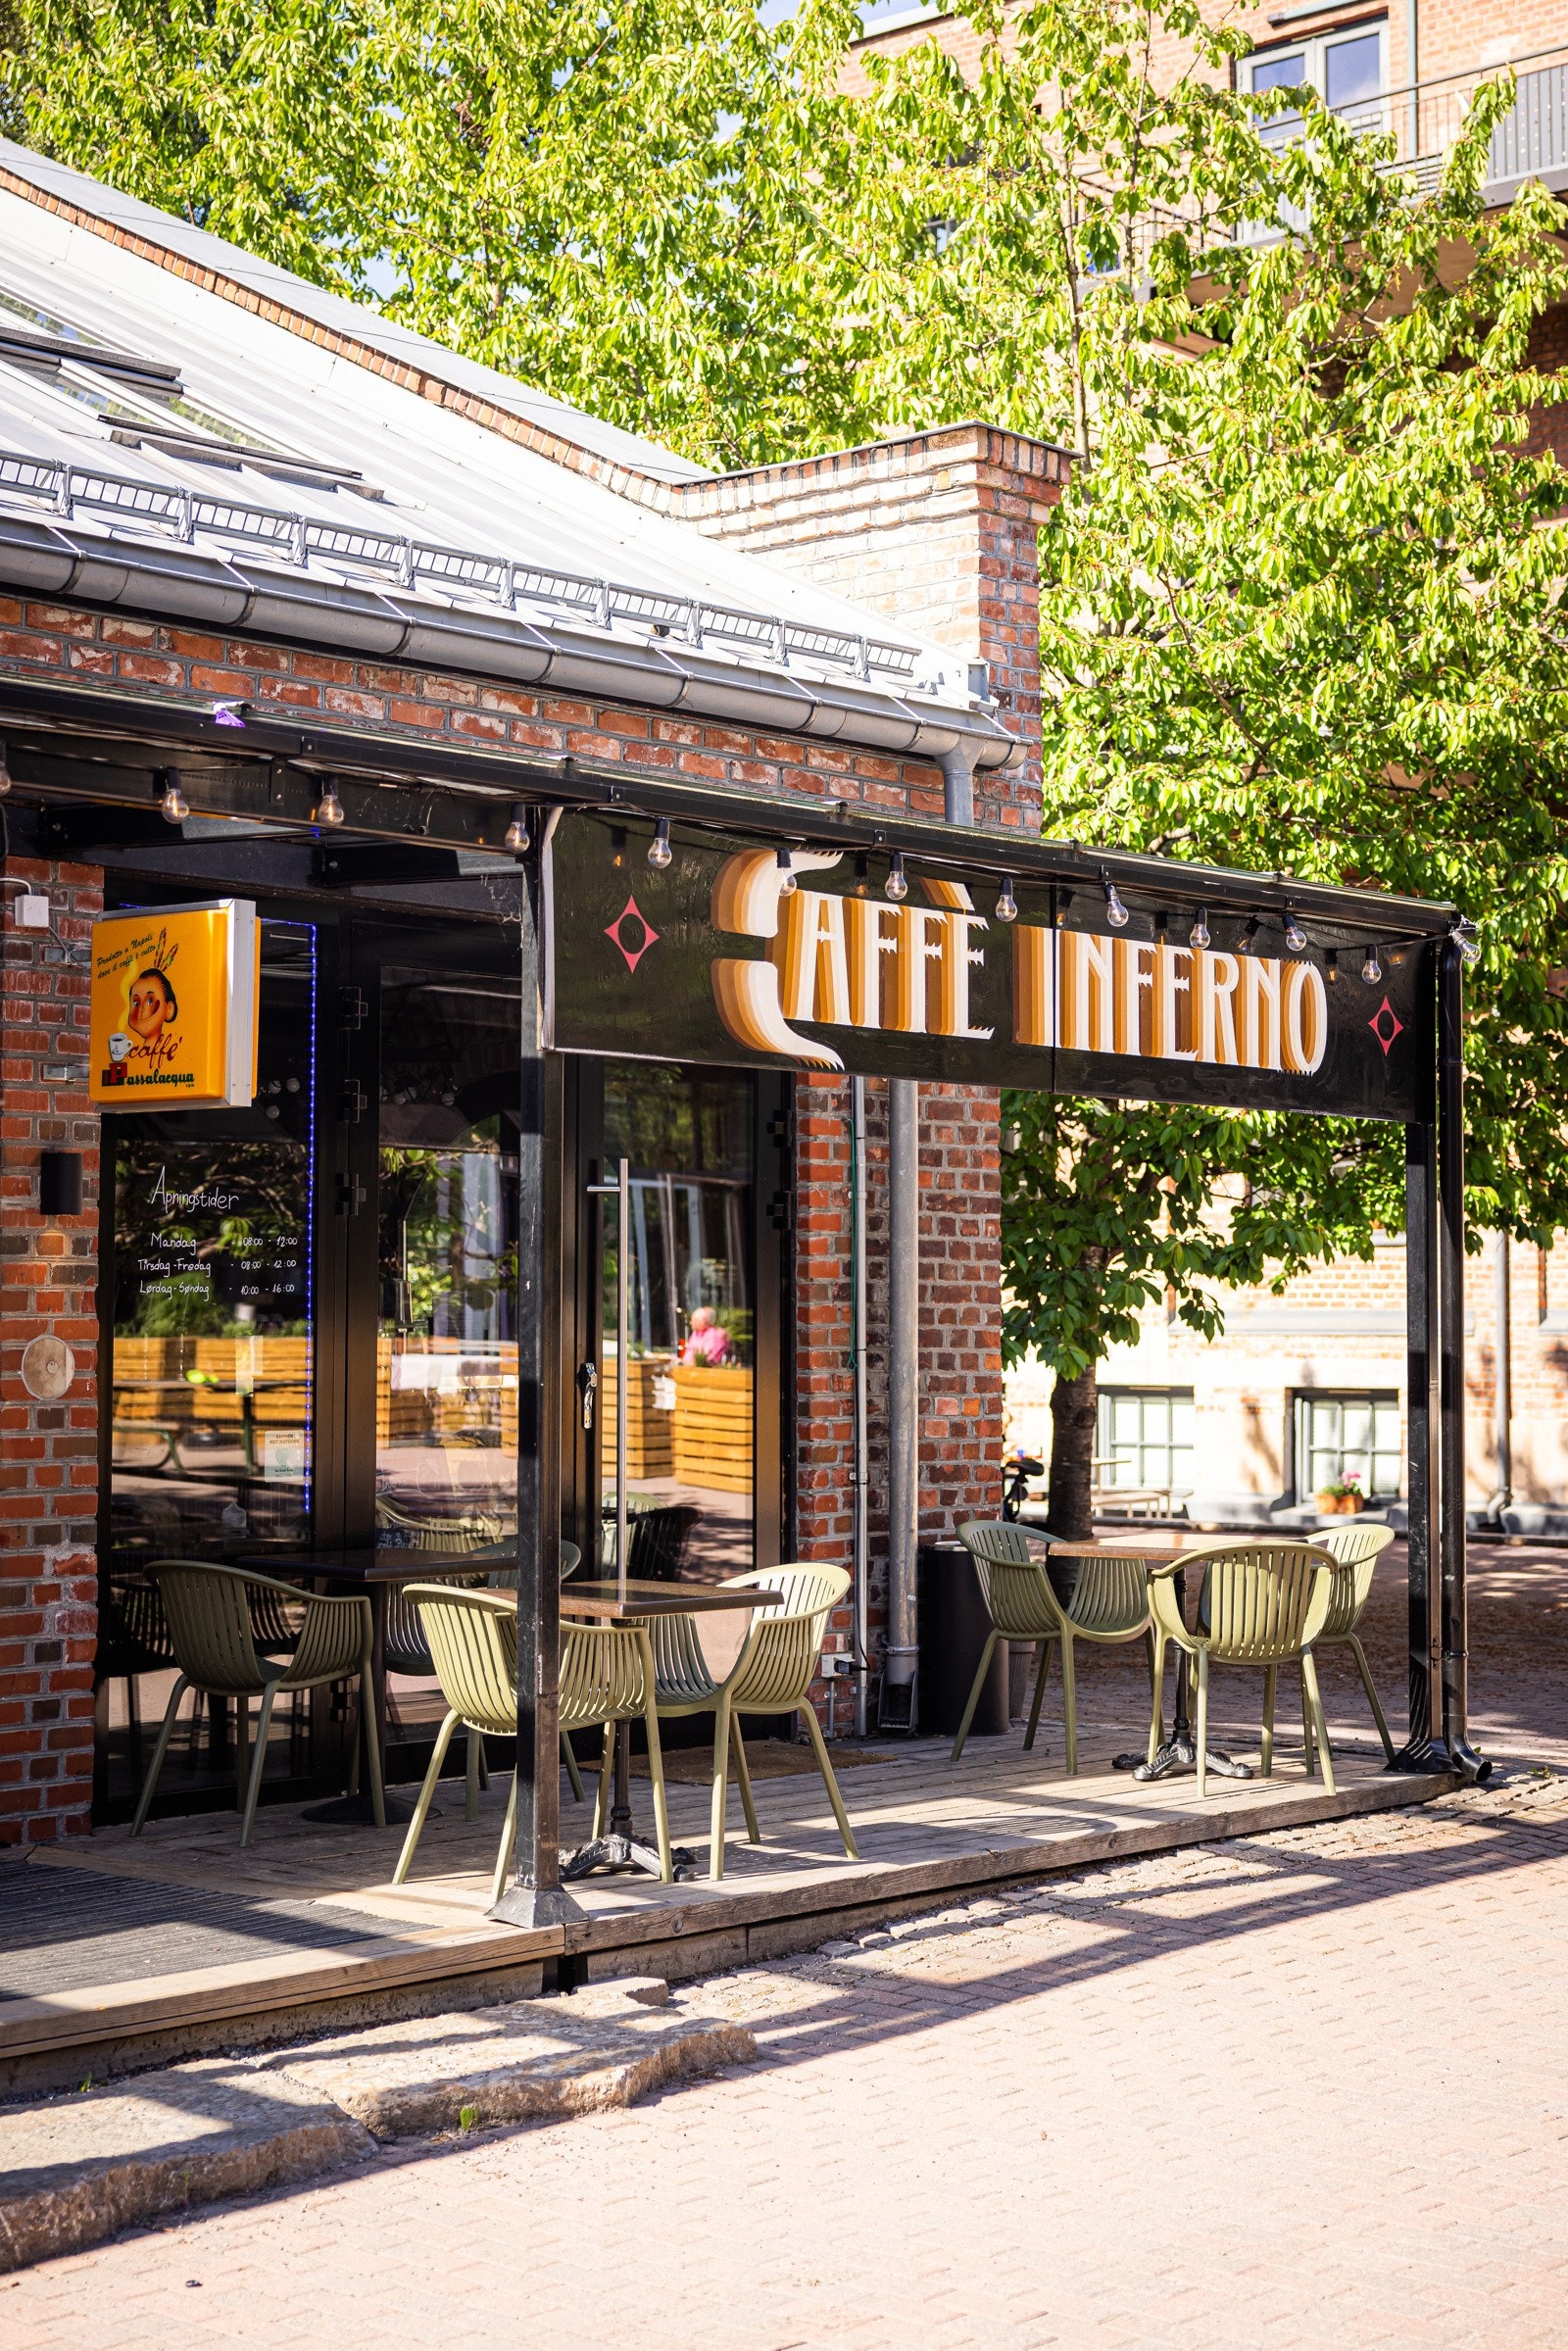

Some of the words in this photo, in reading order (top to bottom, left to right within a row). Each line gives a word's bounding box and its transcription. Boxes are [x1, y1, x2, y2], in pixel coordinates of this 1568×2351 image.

[1012, 924, 1329, 1076] INFERNO
[102, 1062, 195, 1088] Passalacqua
[150, 1232, 197, 1256] Mandag
[276, 1236, 298, 1248] 12:00
[273, 1259, 297, 1269] 12:00
[240, 1285, 260, 1296] 10:00
[271, 1283, 295, 1294] 16:00
